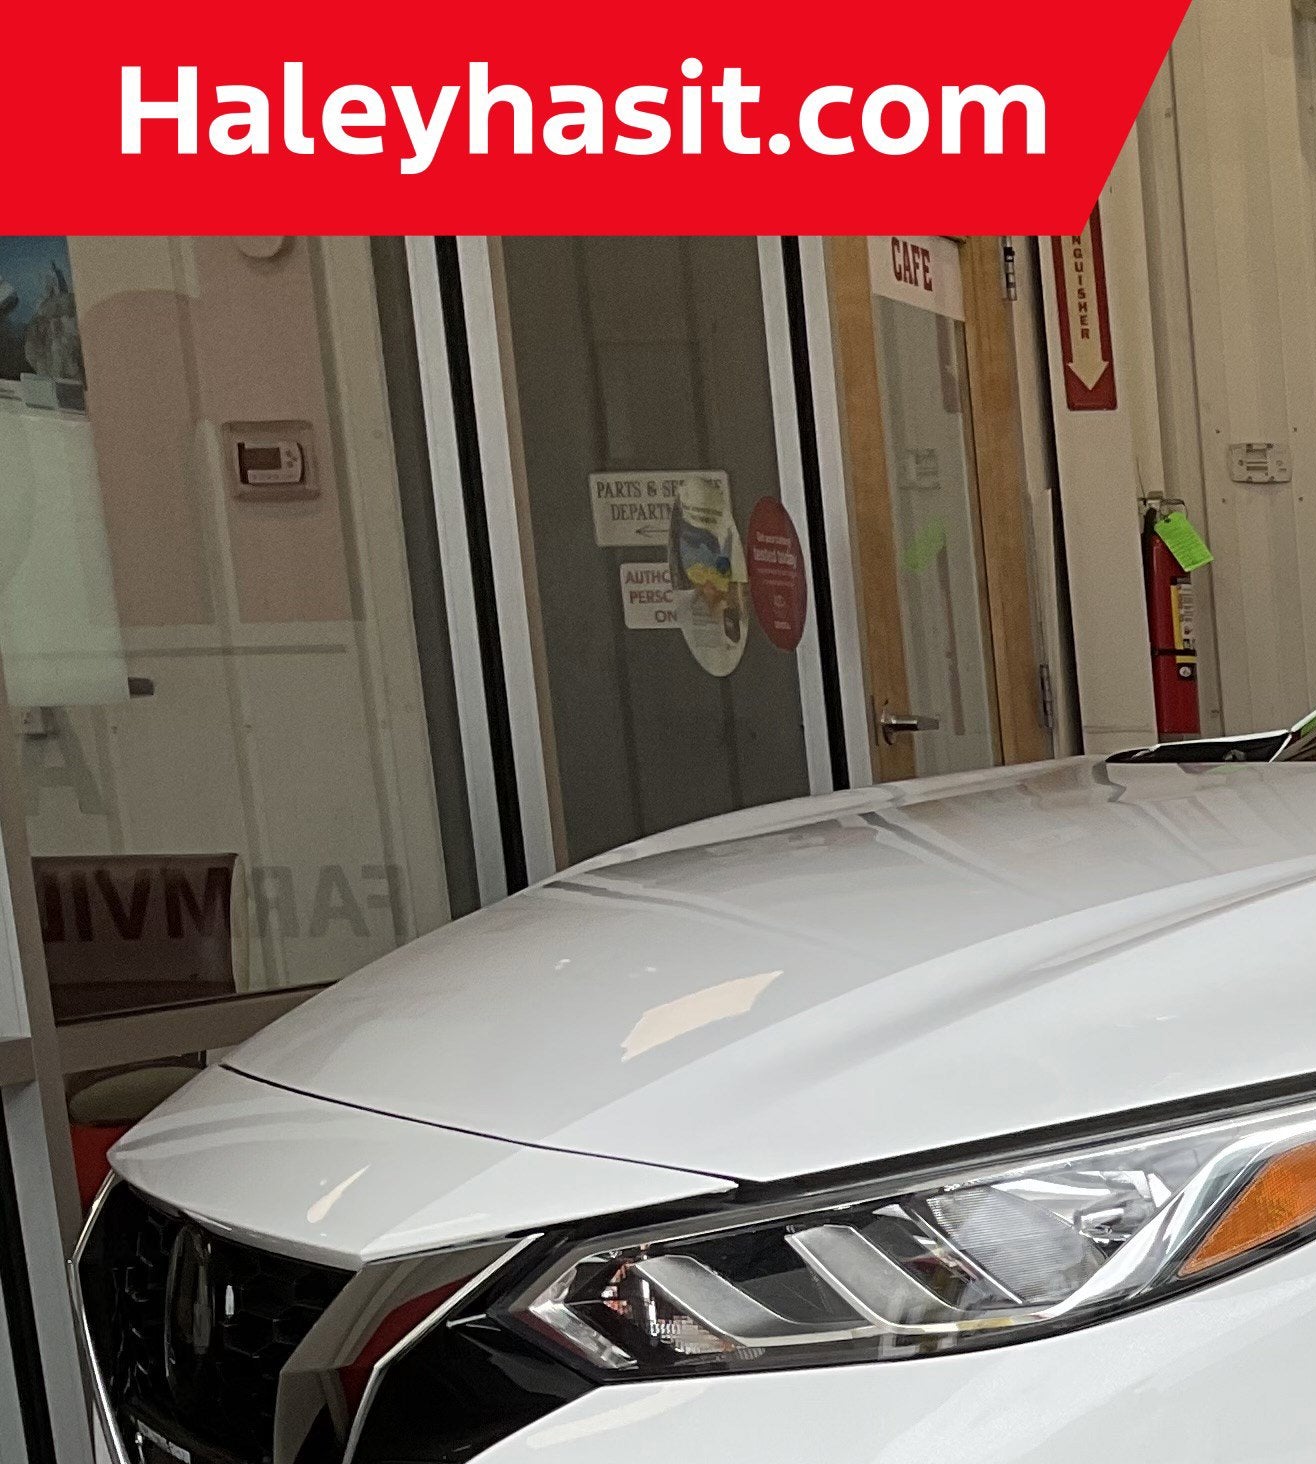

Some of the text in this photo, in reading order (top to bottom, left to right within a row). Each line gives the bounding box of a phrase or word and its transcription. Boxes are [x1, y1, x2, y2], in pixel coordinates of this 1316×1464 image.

[891, 236, 933, 292] CAFE
[1071, 236, 1091, 339] NGUISHER
[596, 481, 642, 499] PARTS
[647, 482, 658, 497] &
